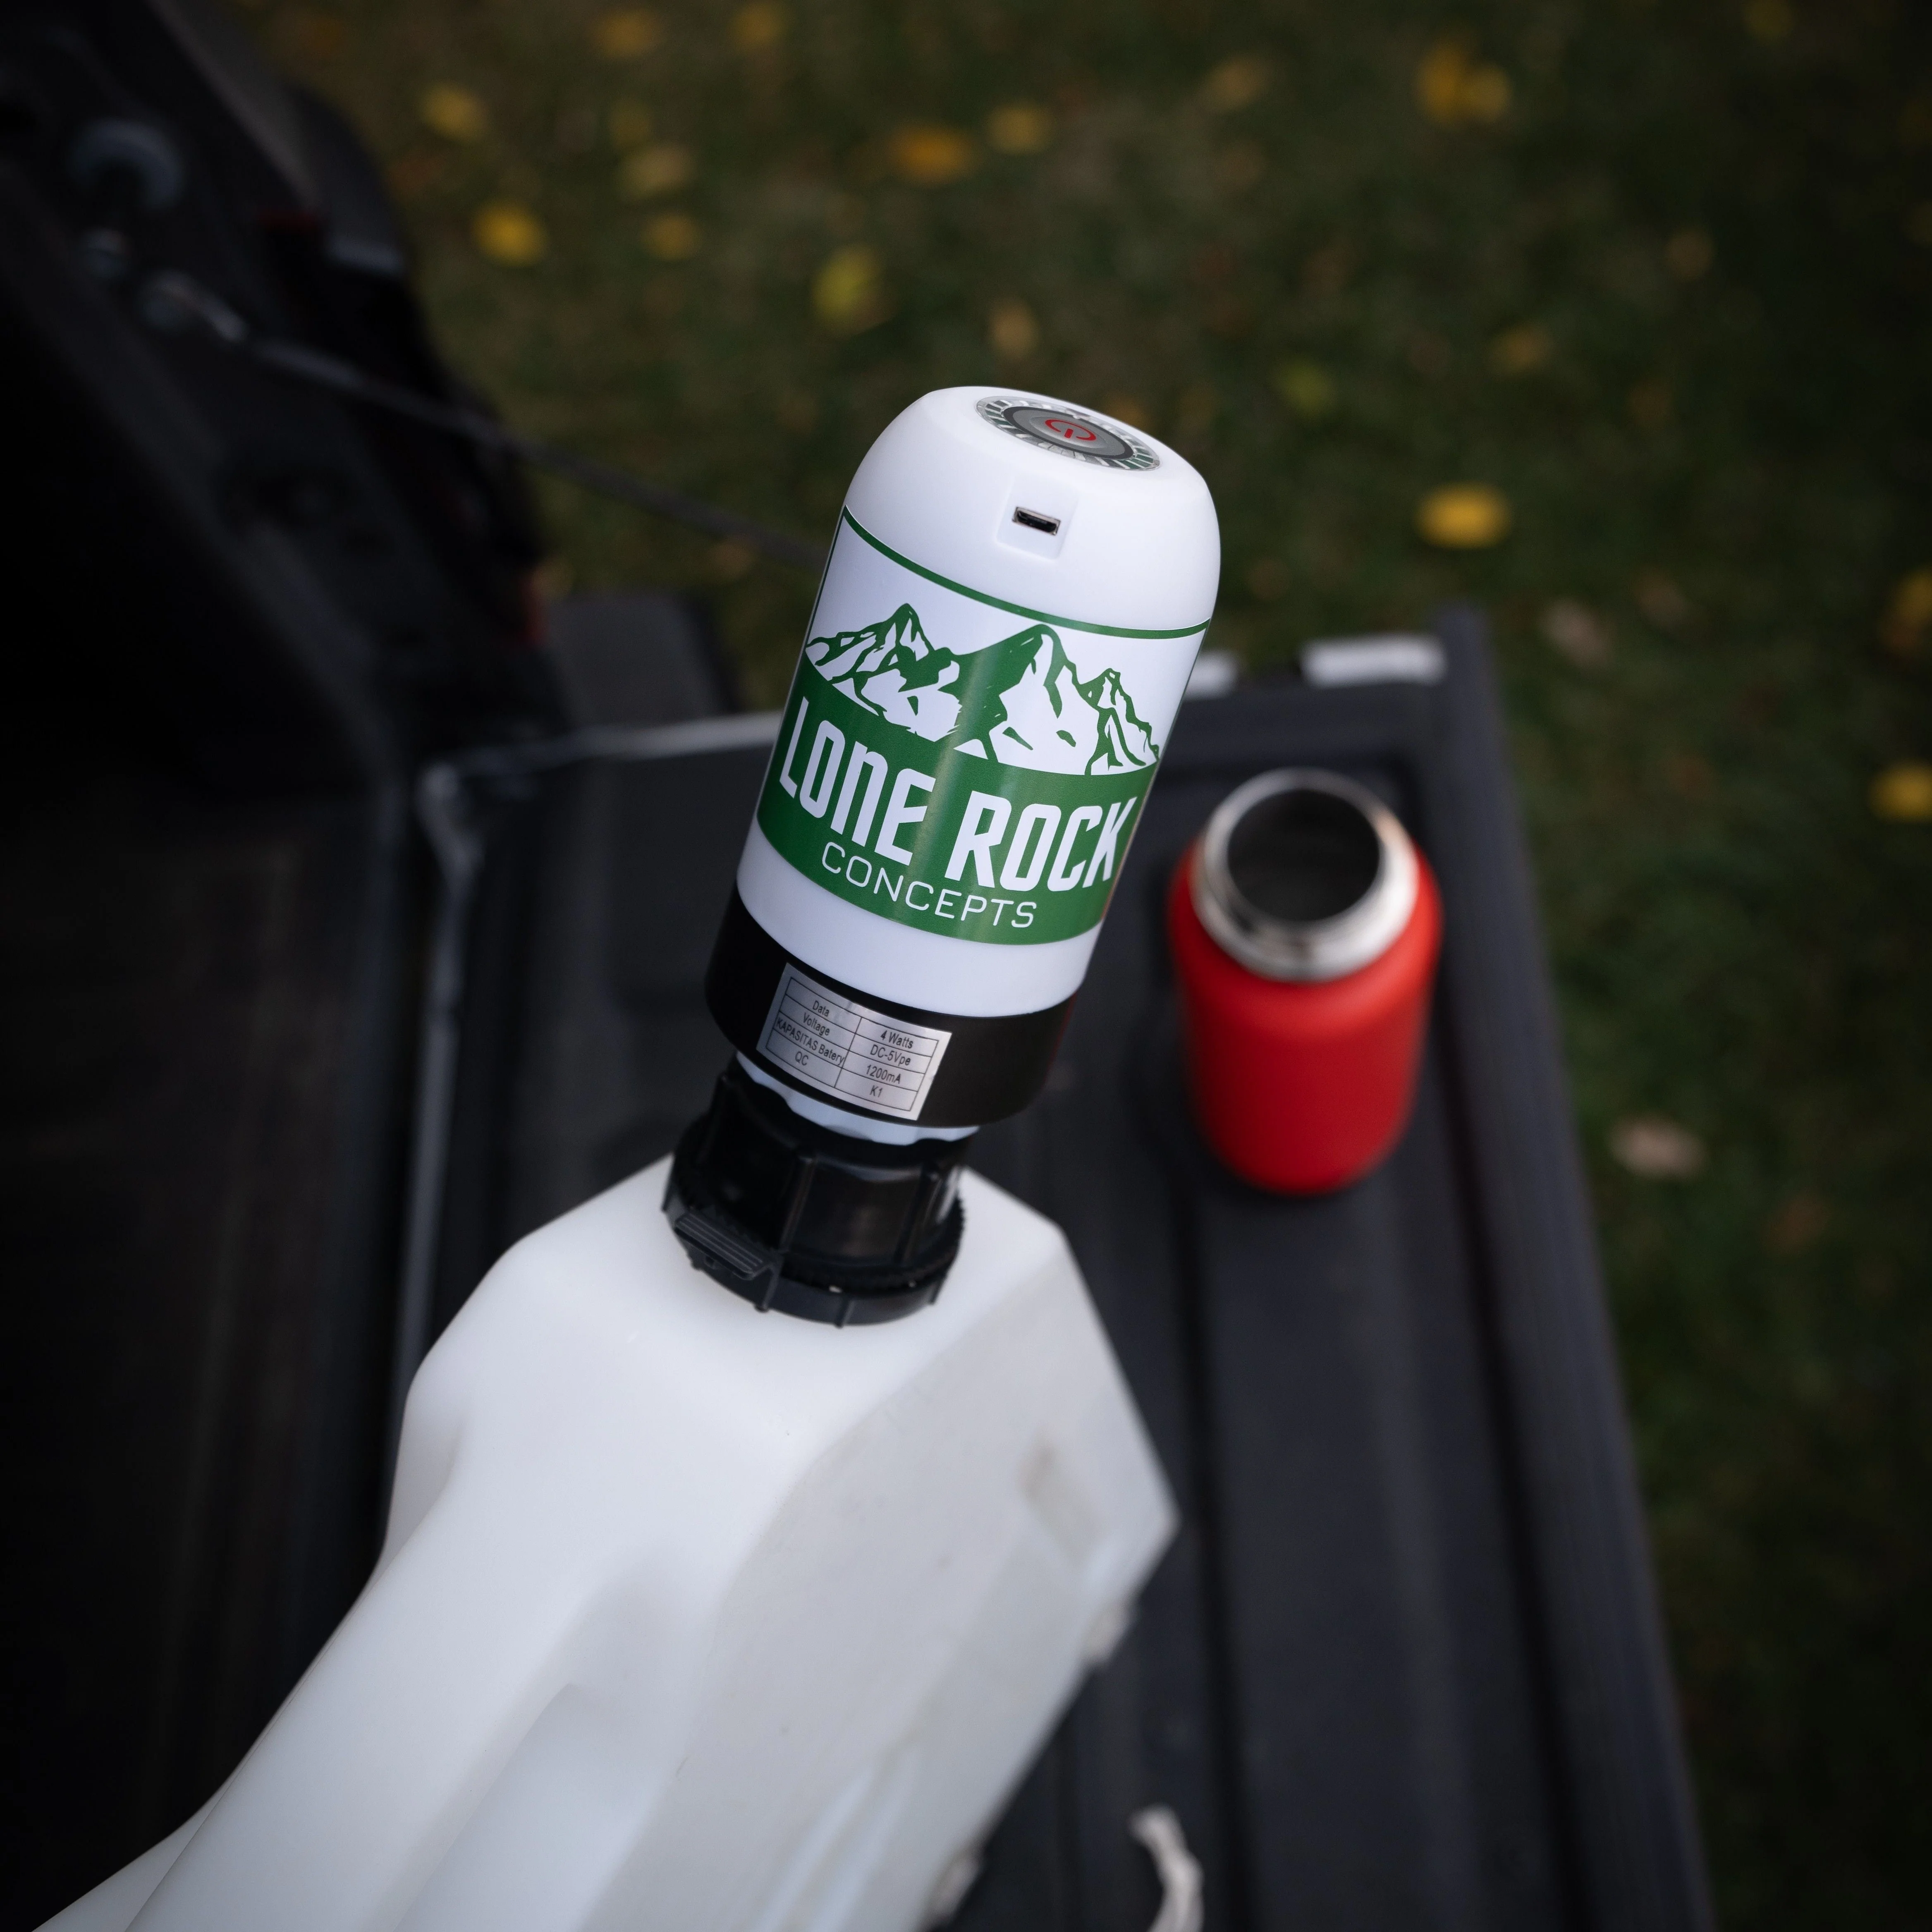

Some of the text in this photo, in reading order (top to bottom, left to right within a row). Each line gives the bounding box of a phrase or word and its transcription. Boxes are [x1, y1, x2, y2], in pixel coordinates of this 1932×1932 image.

[944, 790, 1137, 892] ROCK
[822, 842, 1037, 928] CONCEPTS
[812, 1000, 830, 1017] Data
[803, 1012, 830, 1036] Voltage
[777, 1017, 845, 1065] KAPASITAS Batery
[880, 1030, 913, 1049] 4 Watts
[795, 1051, 809, 1066] QC
[870, 1044, 911, 1066] DC-5Vpe
[866, 1065, 901, 1084] 1200mA
[870, 1085, 882, 1097] K1
